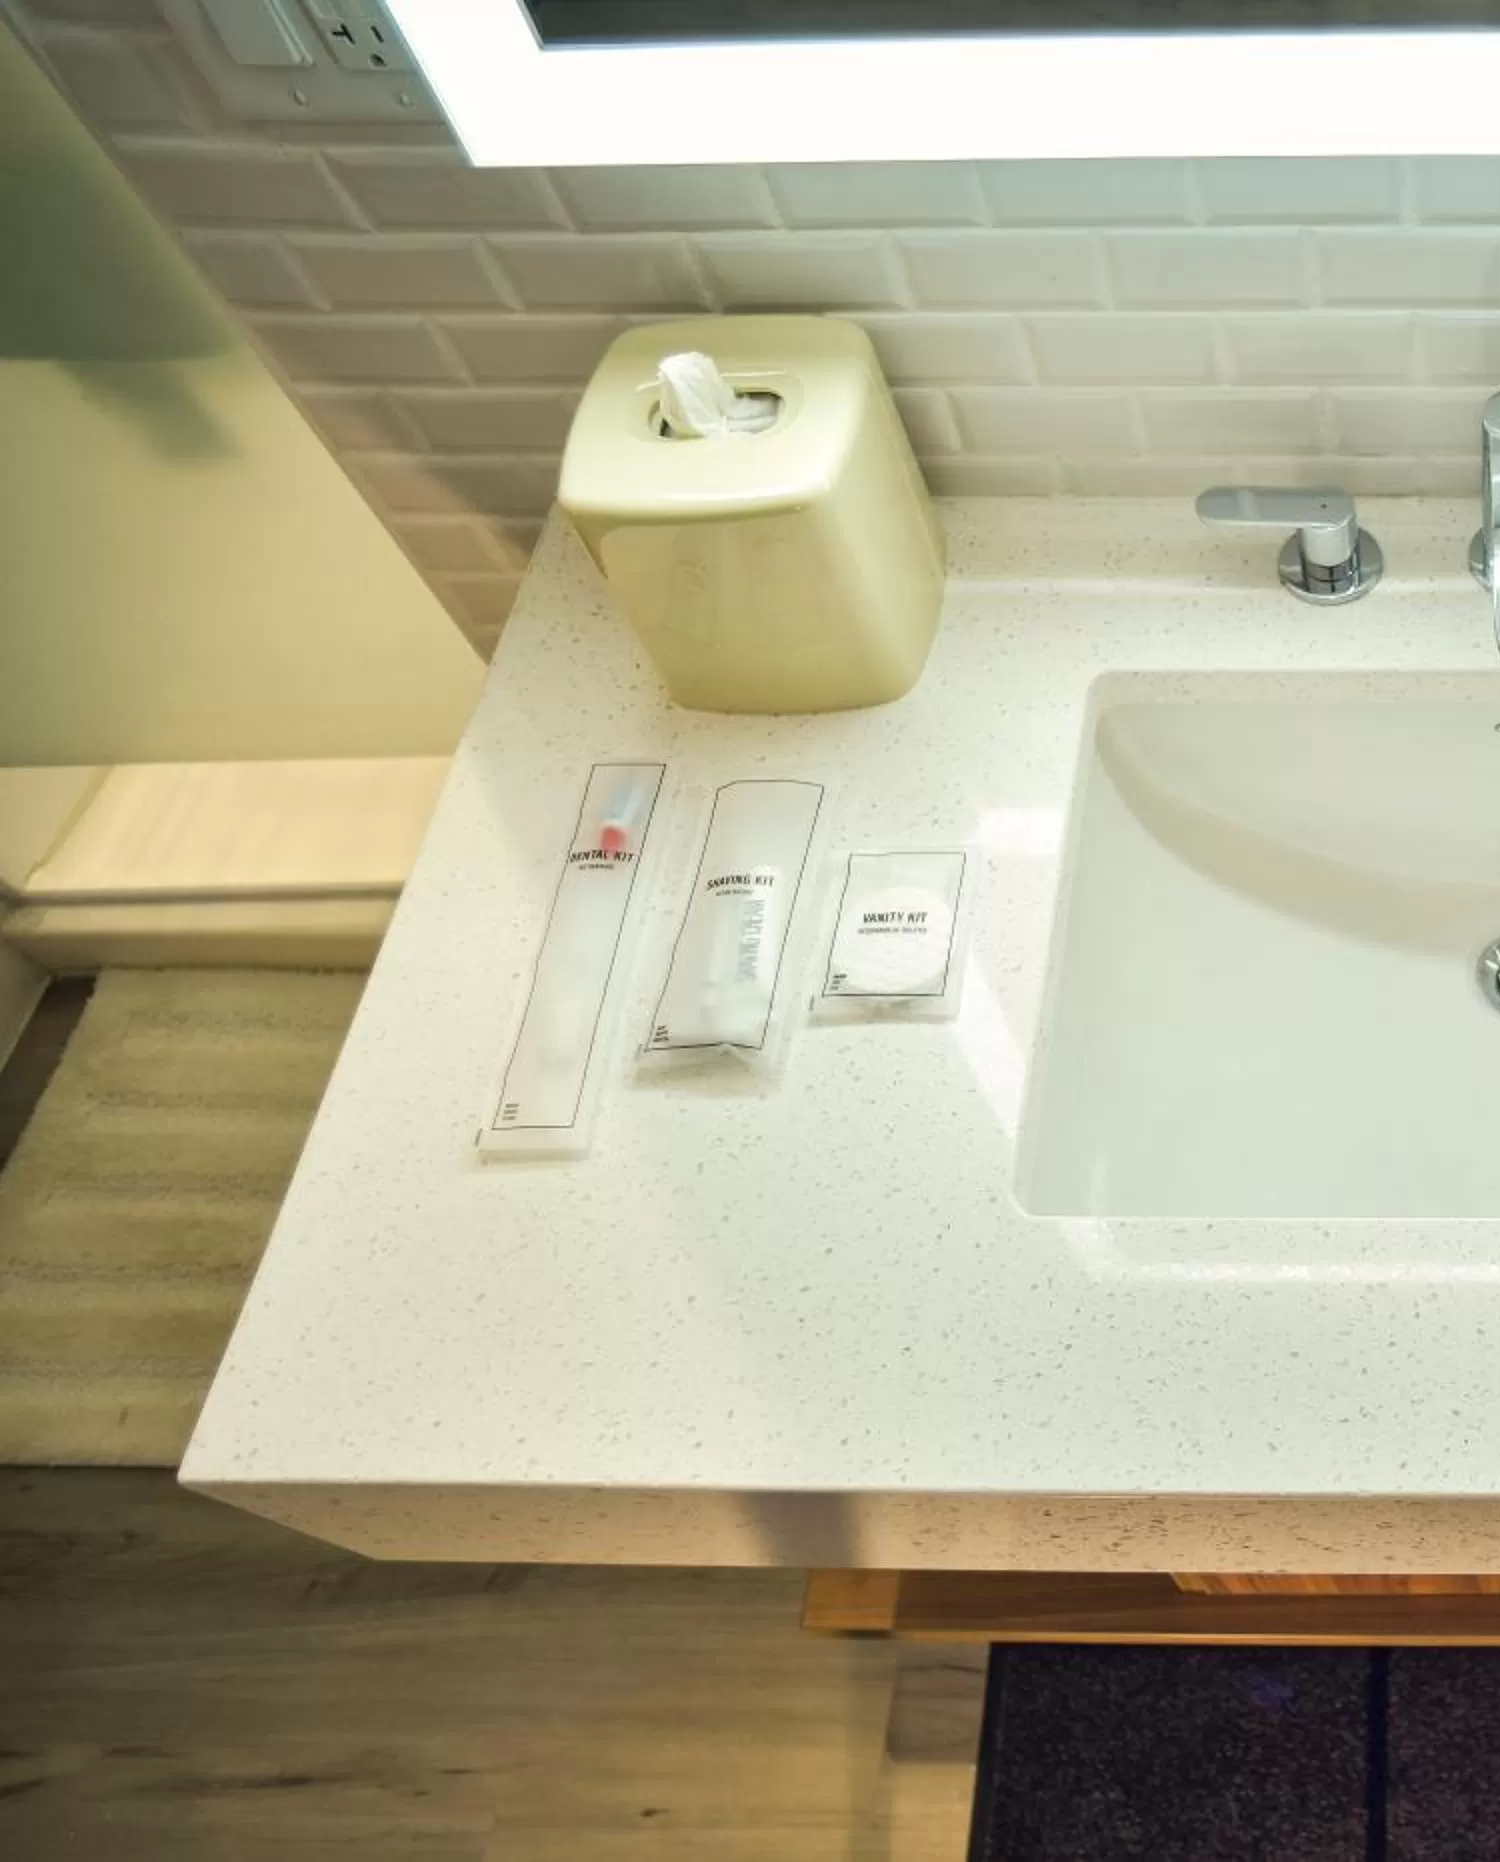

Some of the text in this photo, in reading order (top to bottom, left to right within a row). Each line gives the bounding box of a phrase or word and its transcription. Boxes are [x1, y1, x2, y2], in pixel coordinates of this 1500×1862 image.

[614, 850, 634, 862] KIT
[706, 875, 775, 891] SHAVING KIT
[863, 911, 928, 924] VANITY KIT
